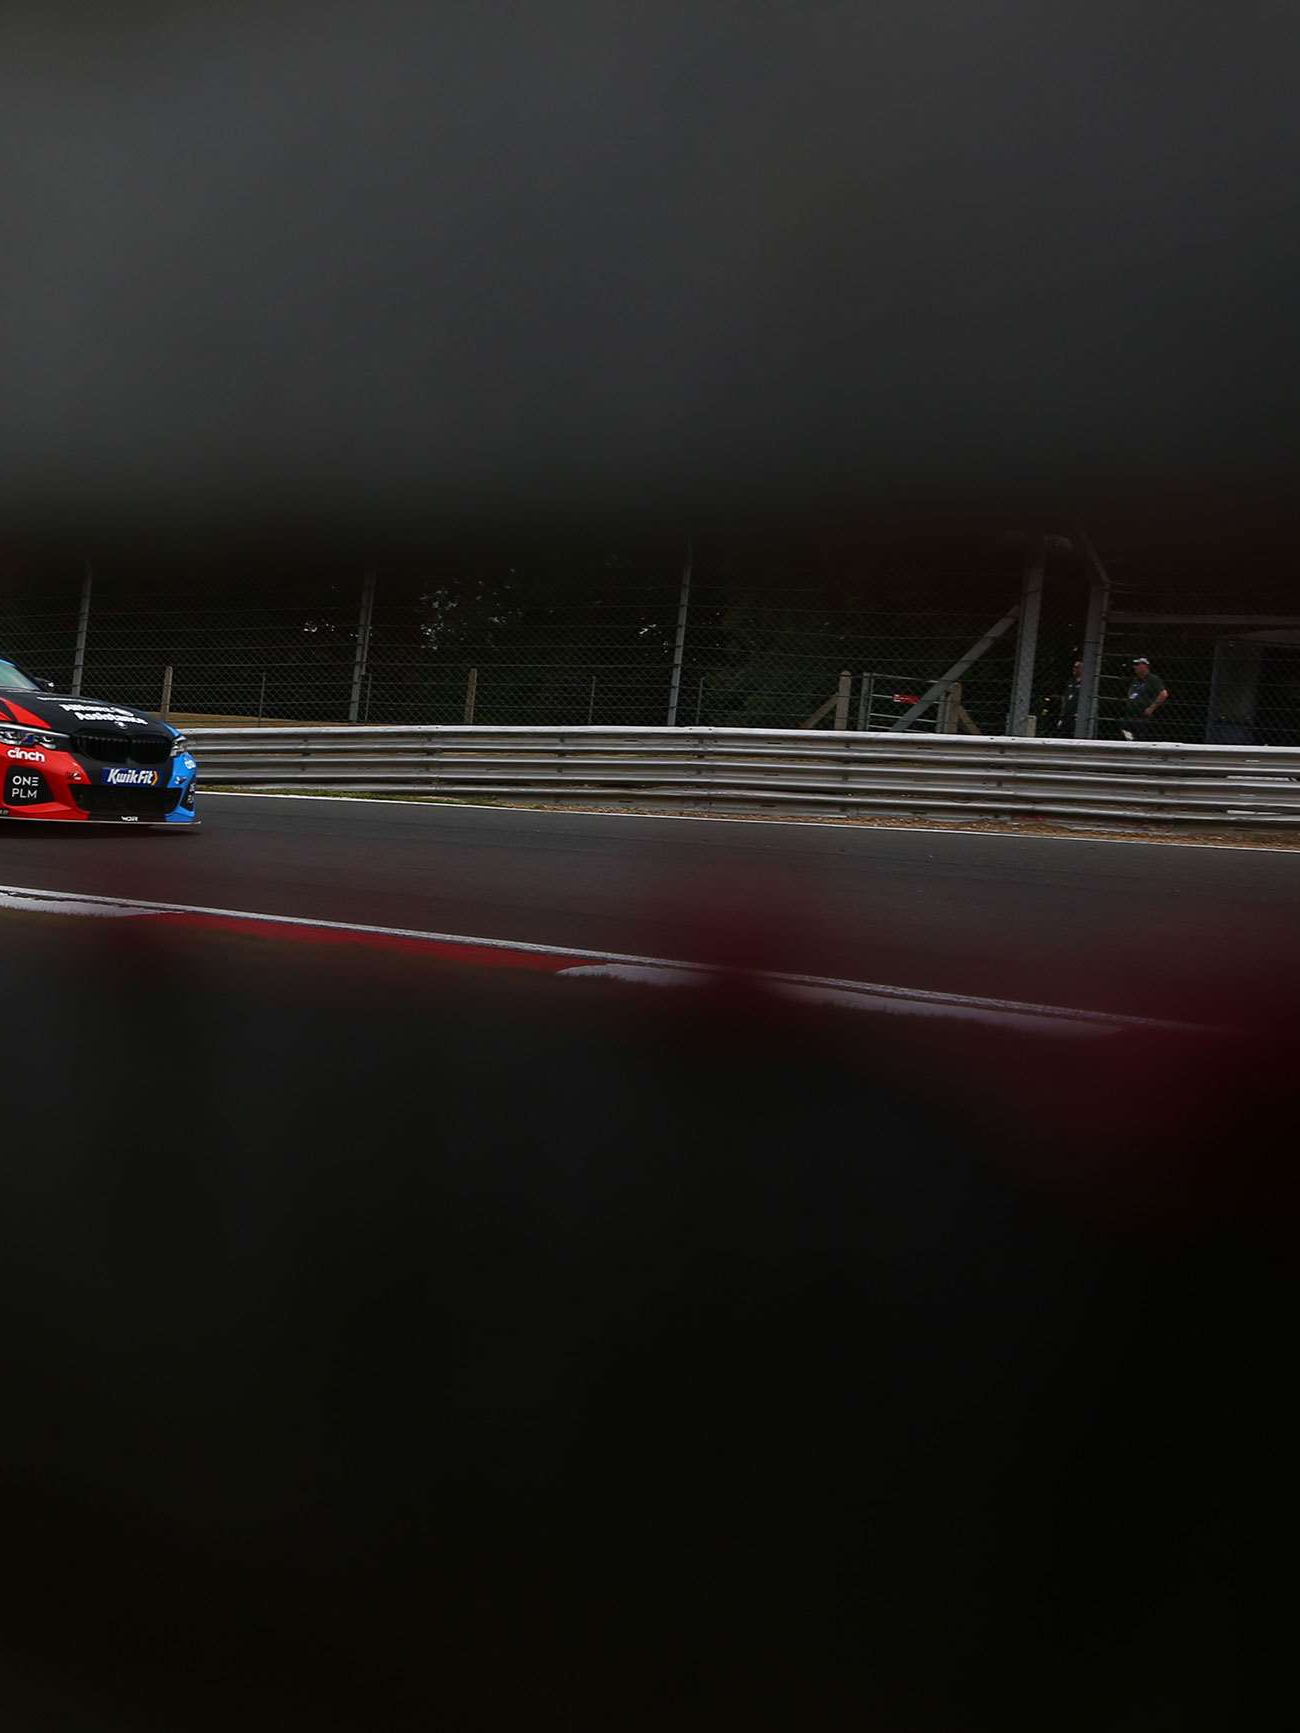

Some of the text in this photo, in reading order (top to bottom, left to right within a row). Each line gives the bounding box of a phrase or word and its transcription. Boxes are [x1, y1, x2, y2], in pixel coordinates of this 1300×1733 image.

[7, 746, 45, 762] cinch
[12, 775, 39, 786] ONE
[11, 787, 38, 799] PLM
